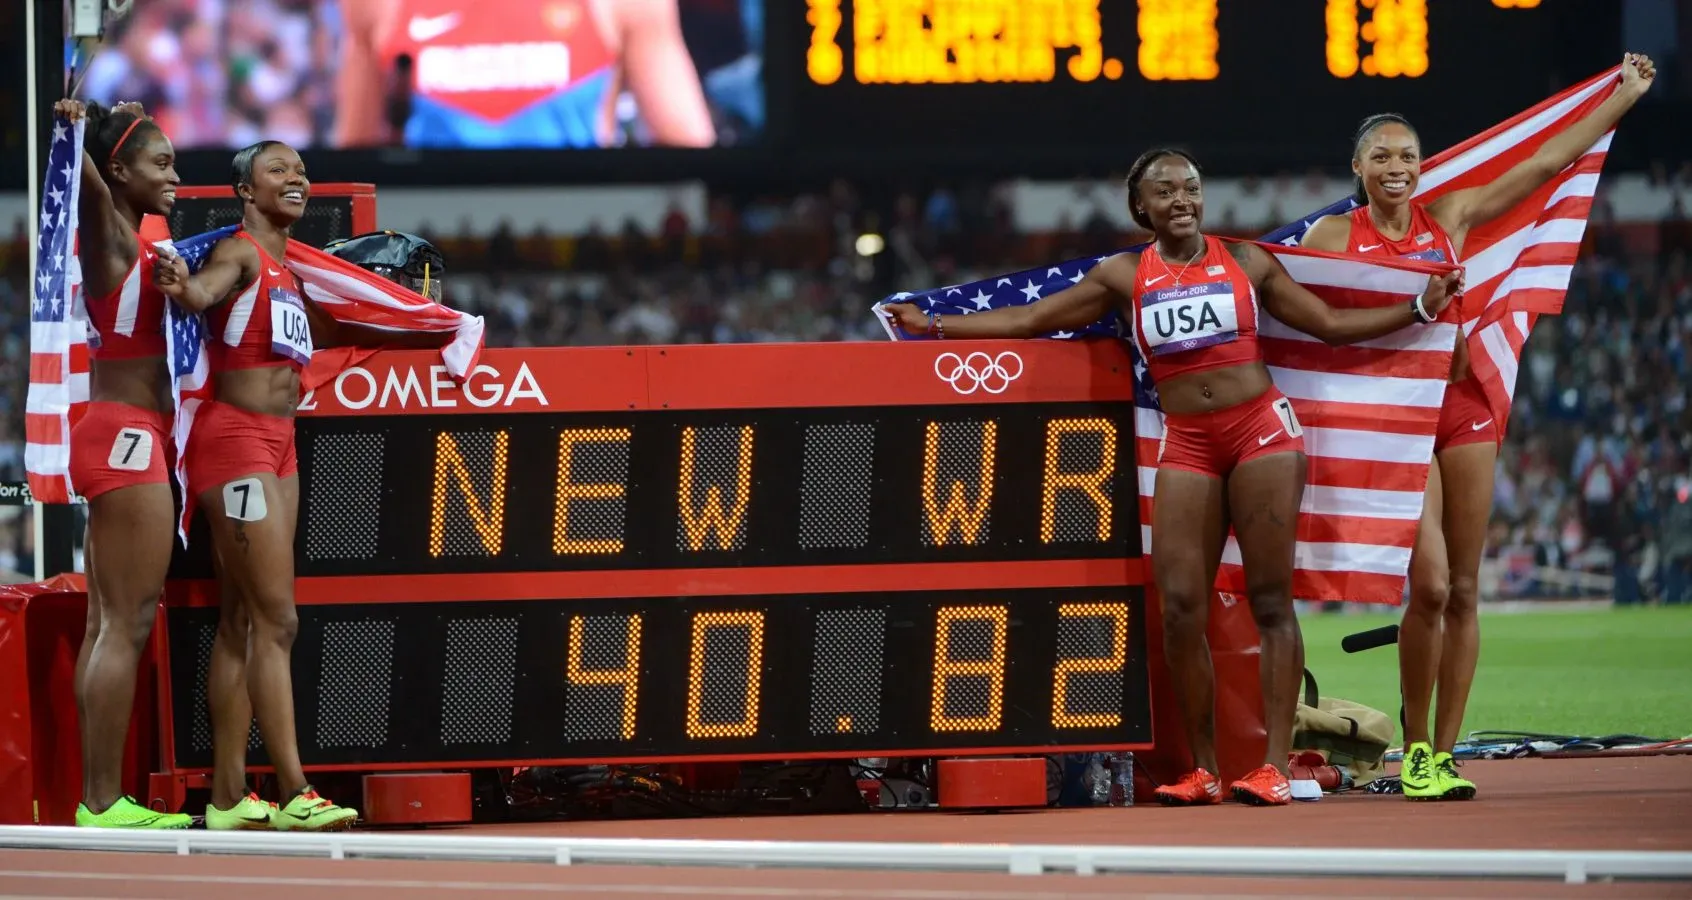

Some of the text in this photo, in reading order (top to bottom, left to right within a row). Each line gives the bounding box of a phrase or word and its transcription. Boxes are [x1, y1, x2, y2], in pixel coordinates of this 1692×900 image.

[1158, 286, 1208, 300] London 2012
[284, 310, 308, 349] USA
[1154, 301, 1222, 337] USA
[334, 361, 549, 410] OMEGA
[1280, 402, 1295, 433] 7
[122, 433, 142, 464] 7
[0, 482, 19, 496] on
[233, 484, 250, 518] 7
[430, 418, 1117, 556] NEW WR
[567, 603, 1128, 739] 40.82
